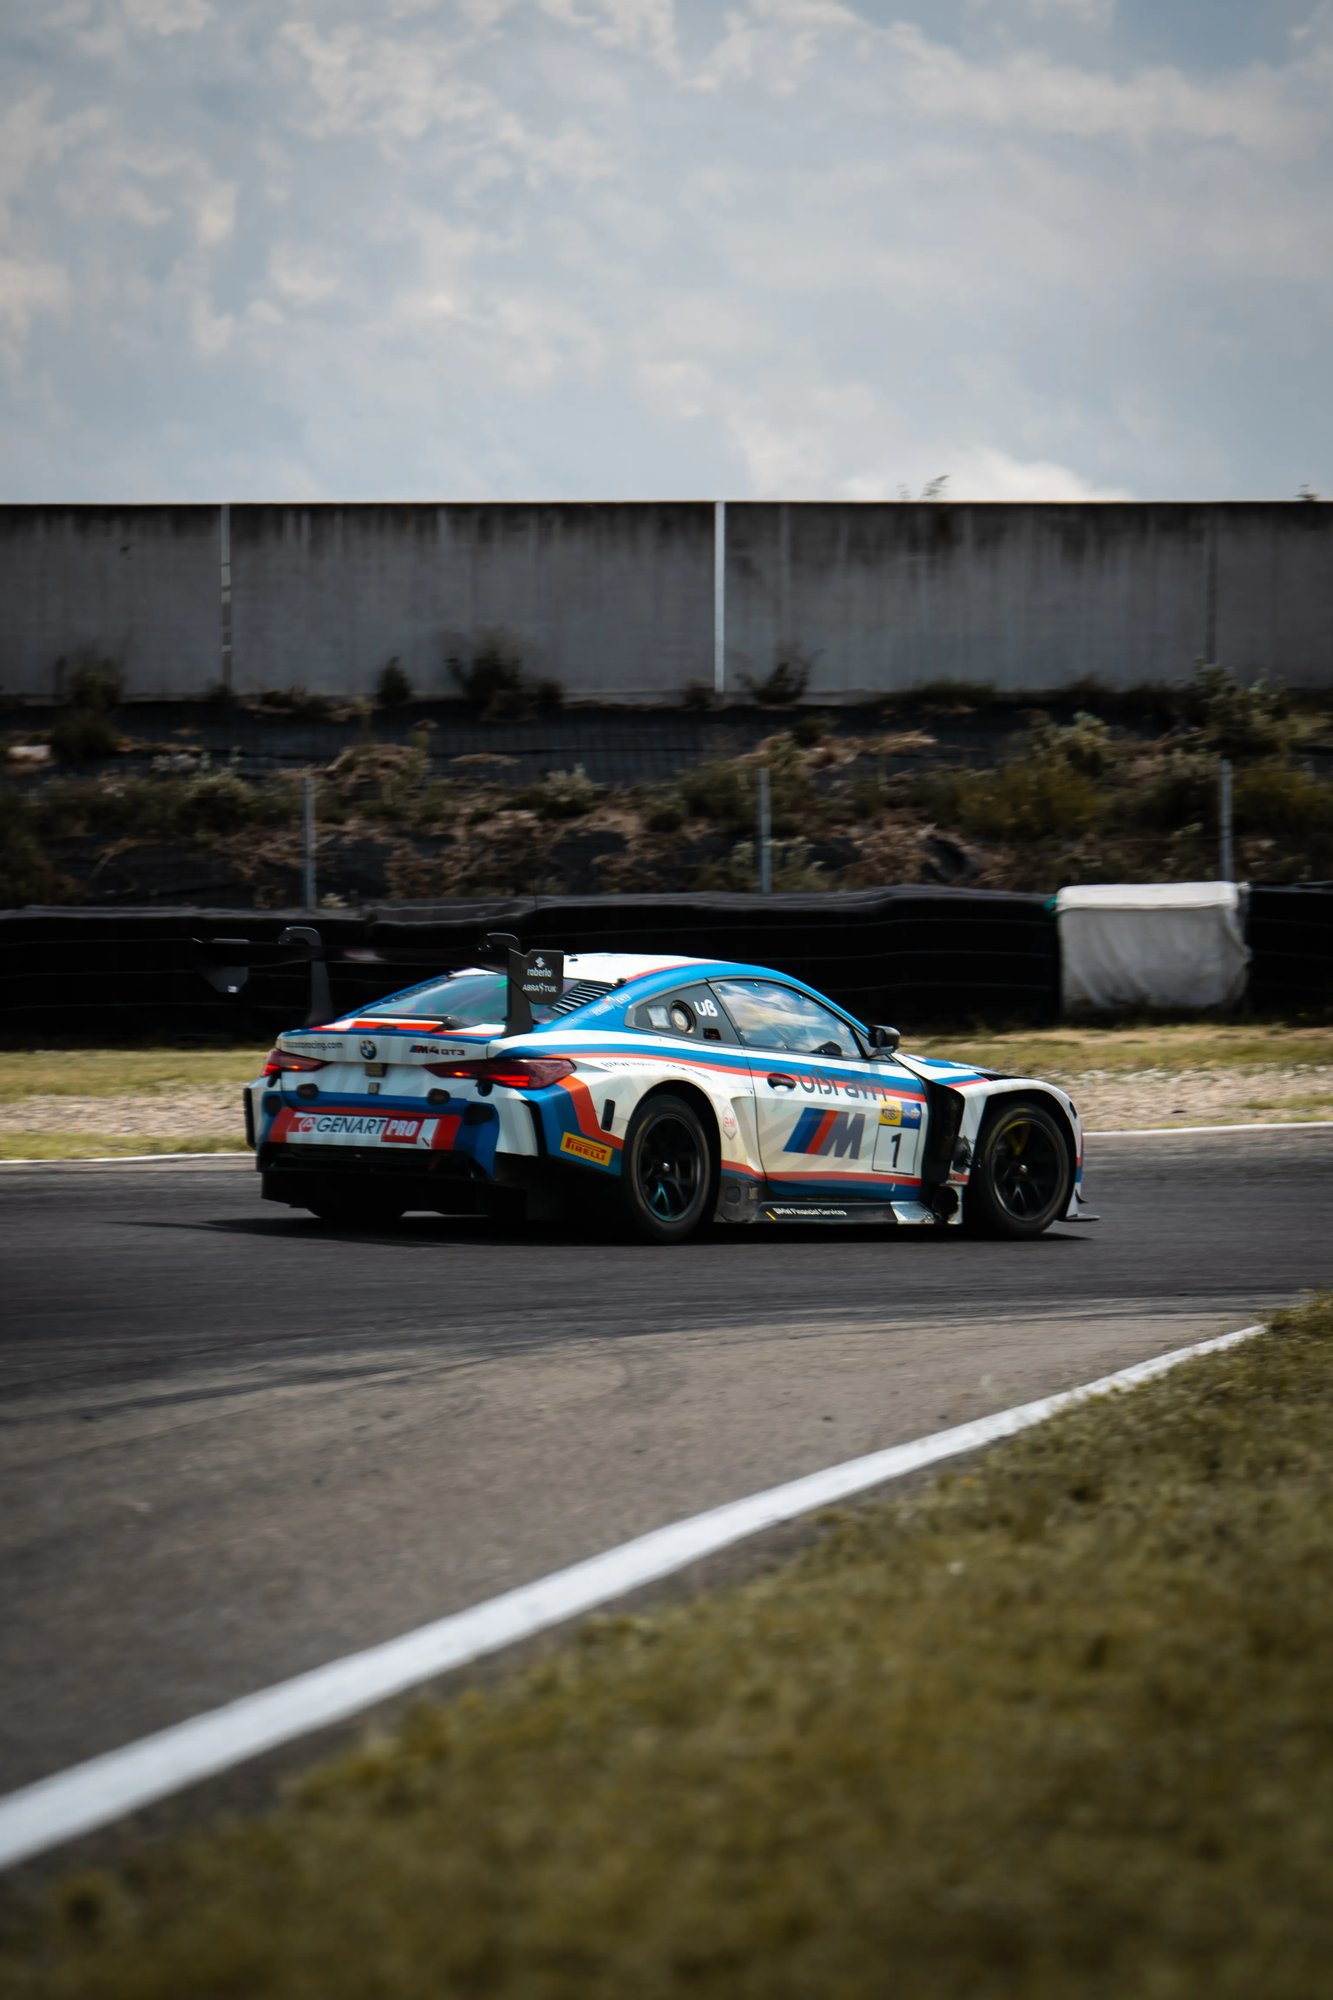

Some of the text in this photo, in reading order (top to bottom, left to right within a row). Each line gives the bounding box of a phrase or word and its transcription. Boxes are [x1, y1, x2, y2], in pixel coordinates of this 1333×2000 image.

[316, 1117, 418, 1137] GENART PRO
[565, 1137, 607, 1160] PIRELLI
[890, 1132, 902, 1169] 1
